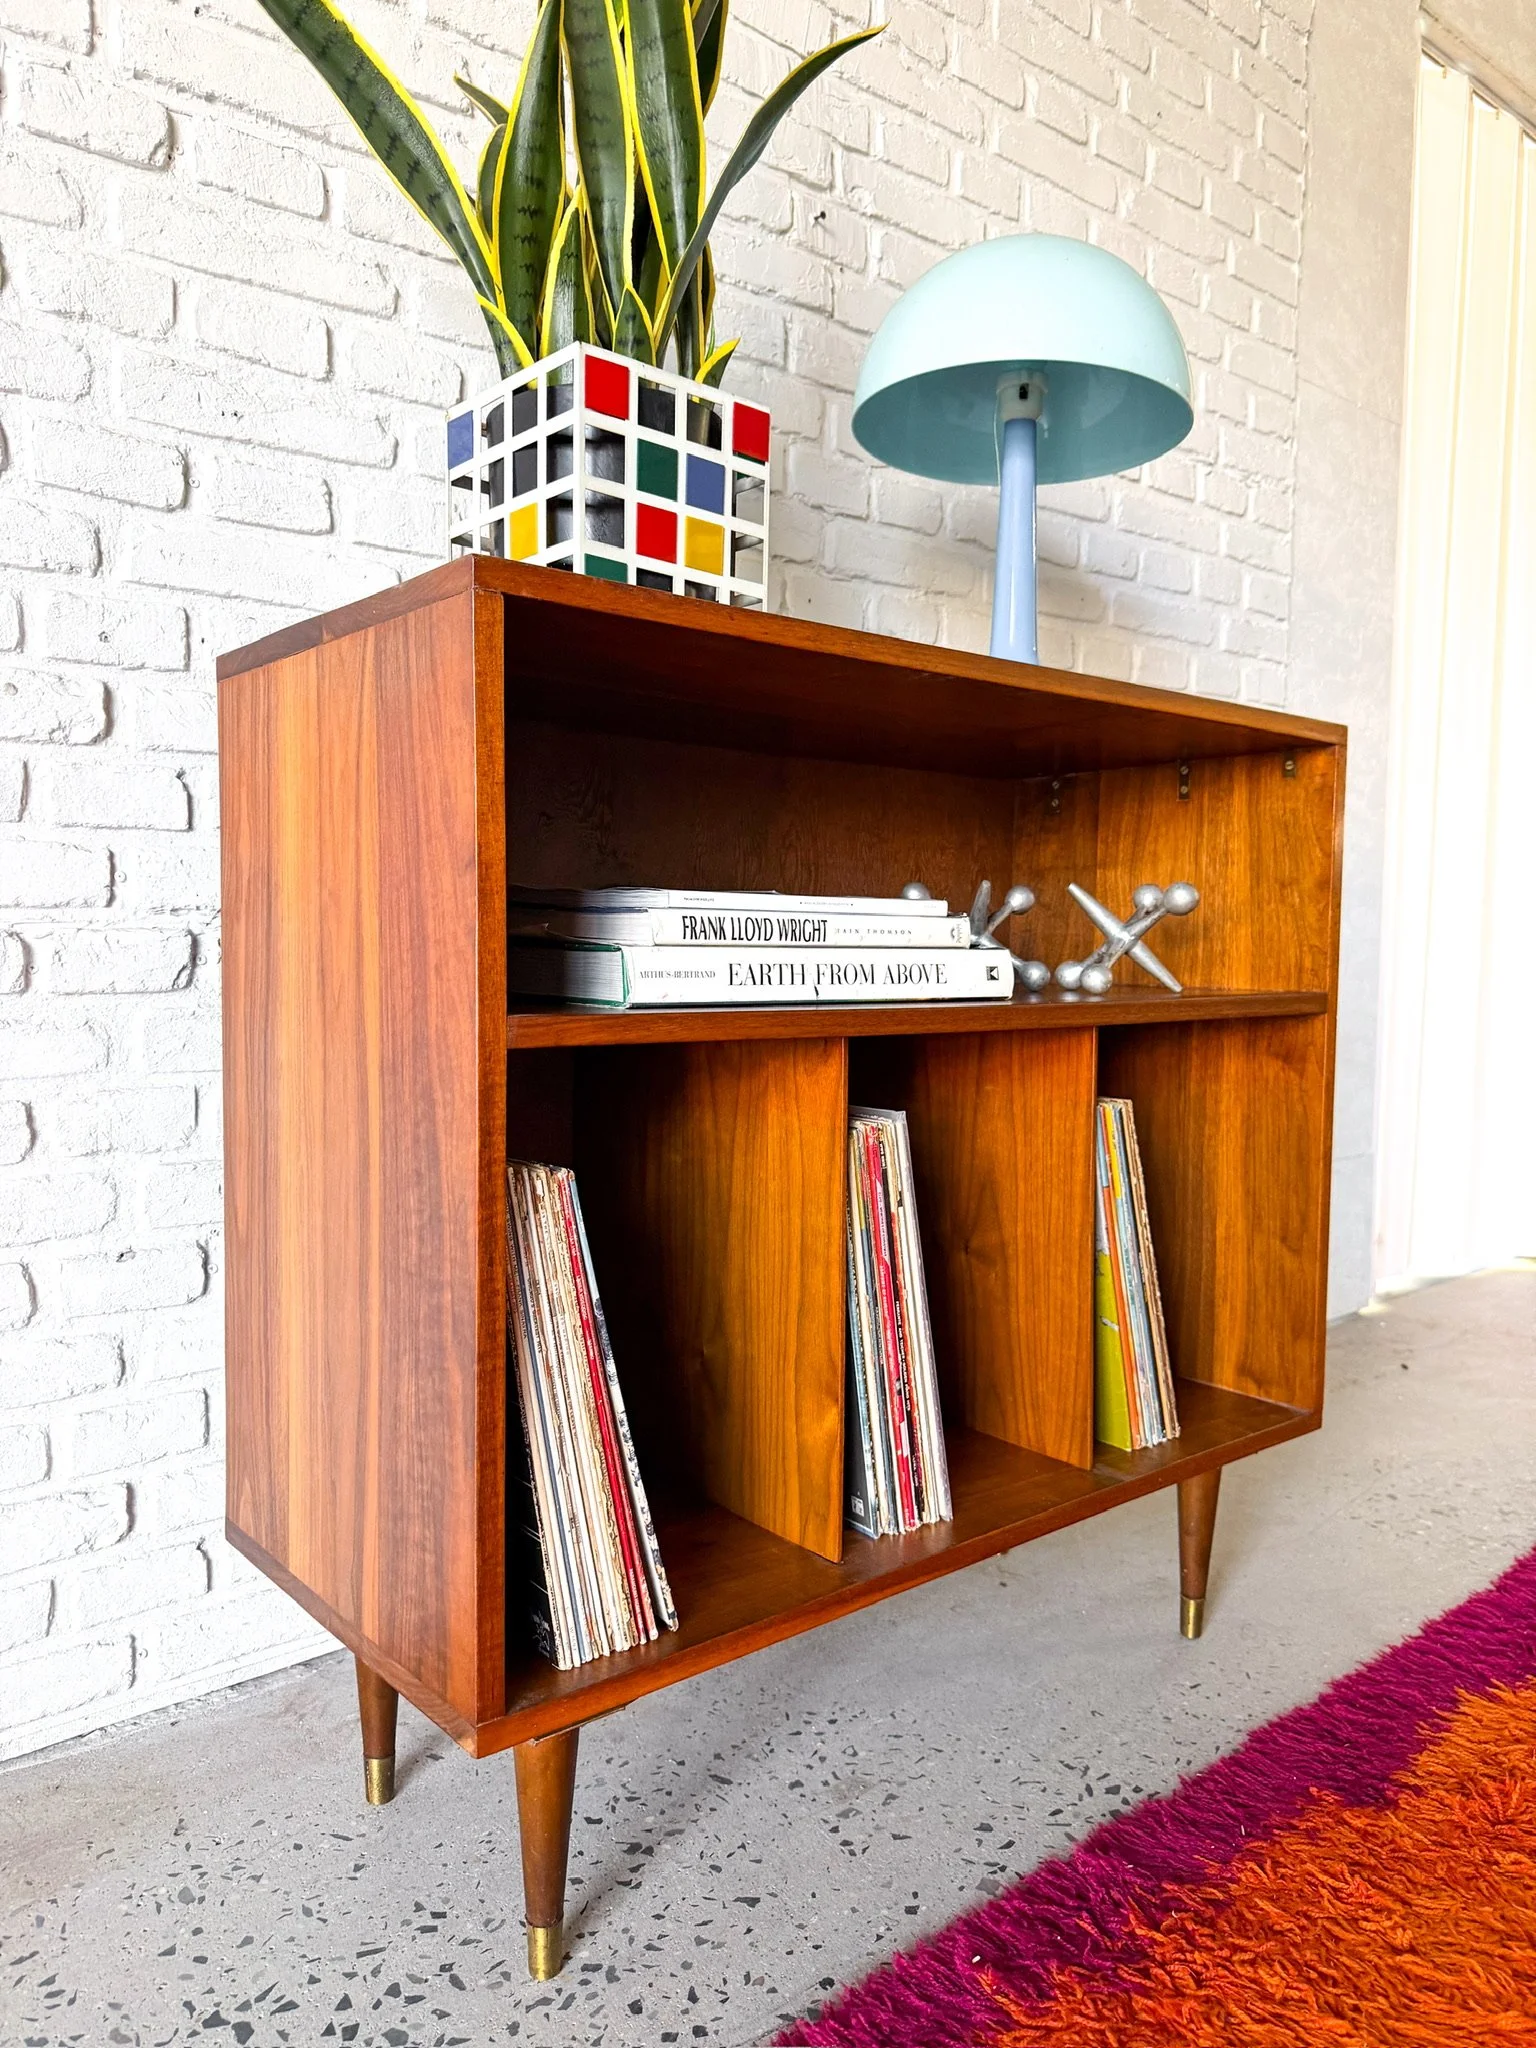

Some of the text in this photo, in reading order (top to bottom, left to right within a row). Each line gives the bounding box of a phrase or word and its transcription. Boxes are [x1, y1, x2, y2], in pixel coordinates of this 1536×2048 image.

[682, 915, 827, 942] FRANK LLOYD WRIGHT
[639, 963, 947, 986] ARTHUS-BERTRAND EARTH FROM ABOVE
